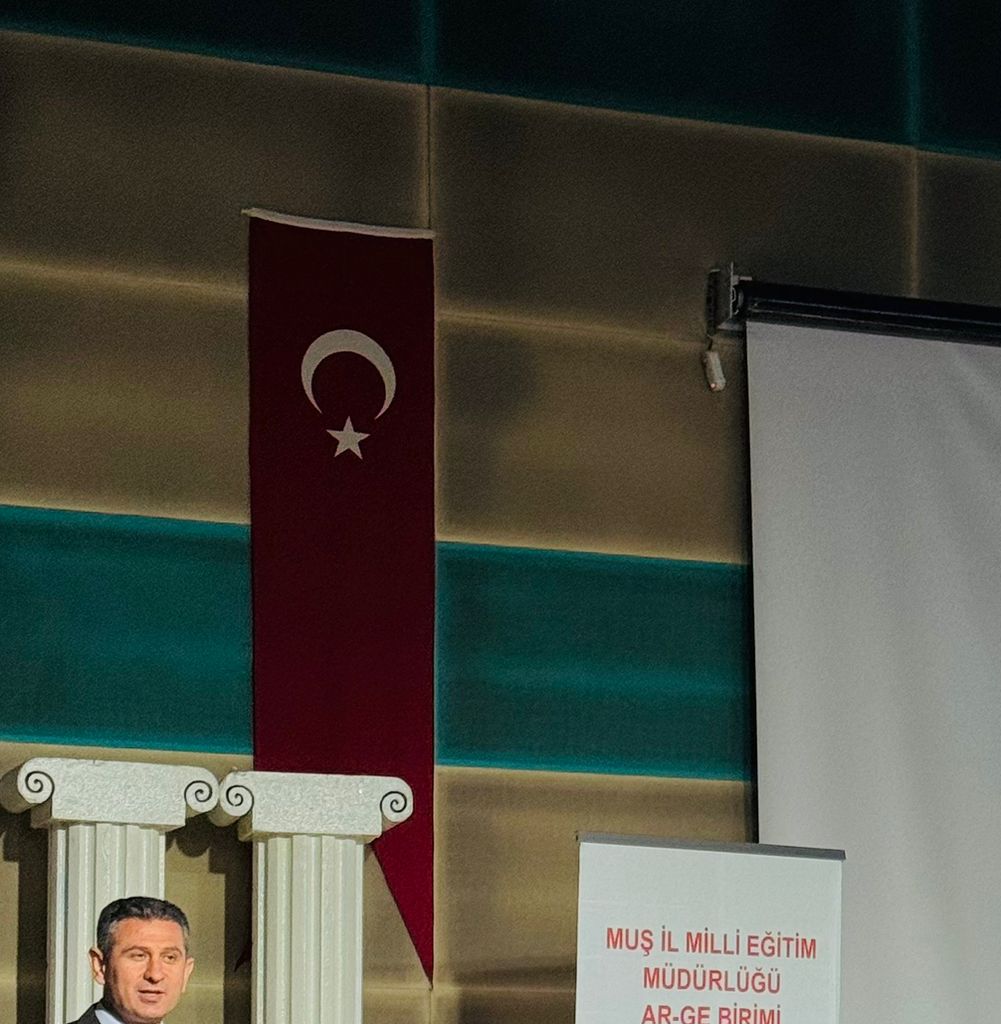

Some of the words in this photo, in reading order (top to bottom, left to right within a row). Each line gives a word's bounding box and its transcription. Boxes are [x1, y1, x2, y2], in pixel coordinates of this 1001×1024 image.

[606, 927, 654, 957] MUŞ
[661, 925, 679, 953] İL
[686, 927, 740, 956] MİLLİ
[747, 930, 816, 959] EĞİTİM
[643, 962, 781, 994] MÜDÜRLÜĞÜ
